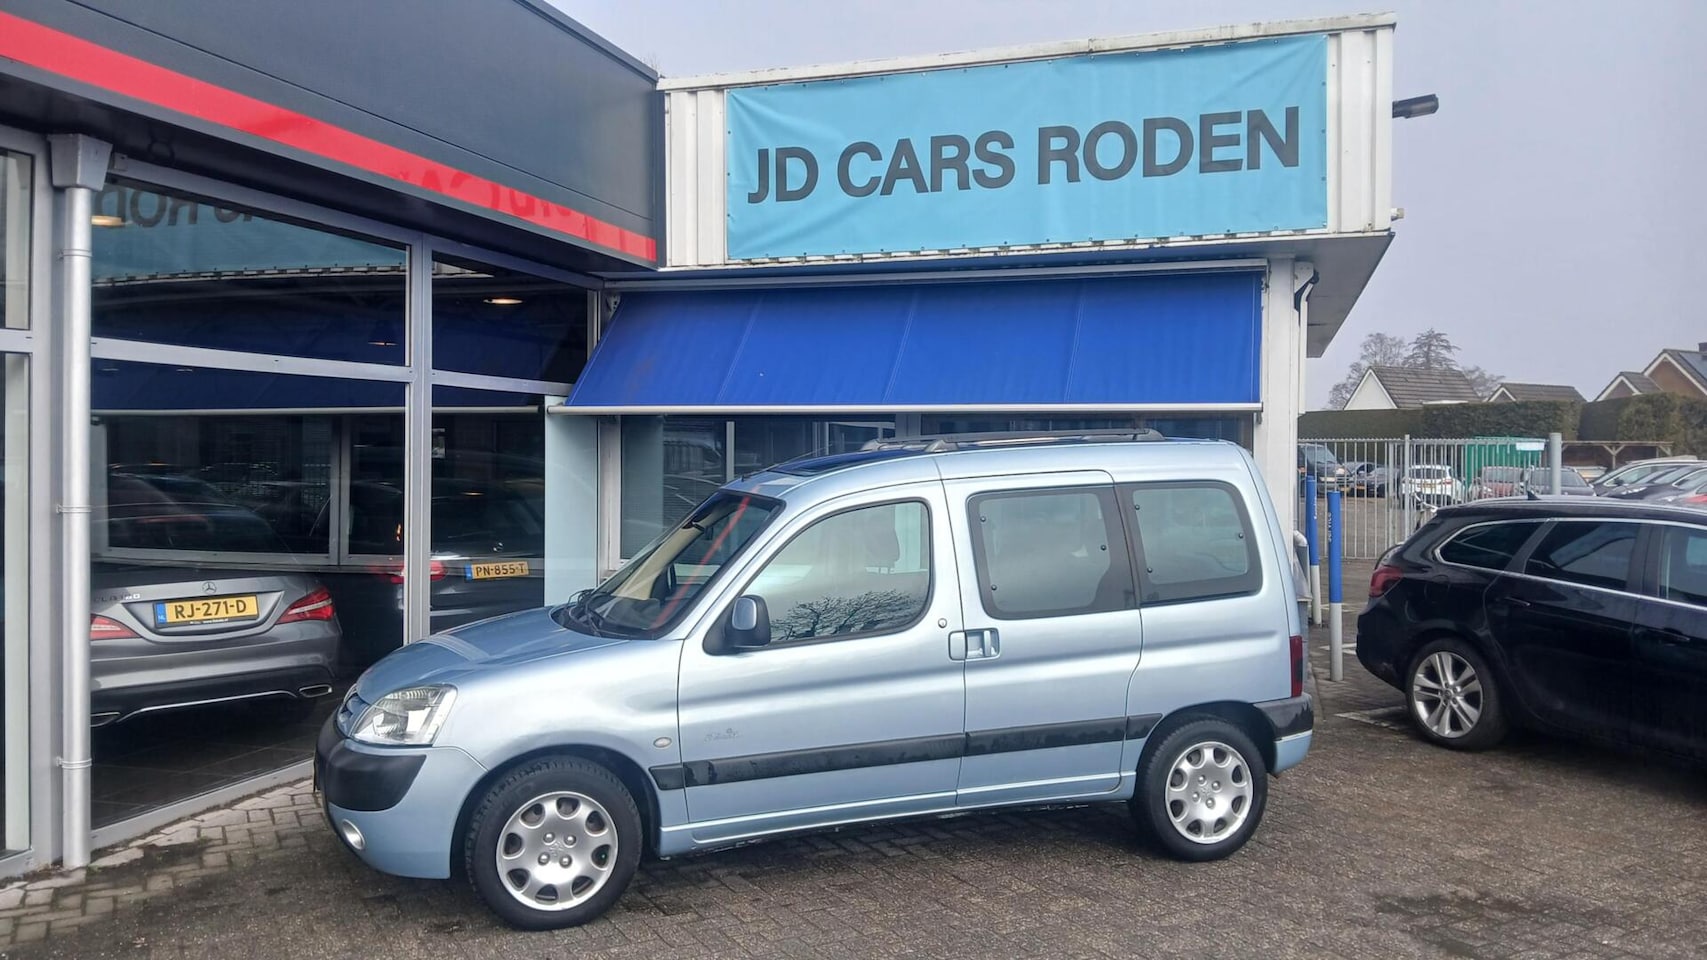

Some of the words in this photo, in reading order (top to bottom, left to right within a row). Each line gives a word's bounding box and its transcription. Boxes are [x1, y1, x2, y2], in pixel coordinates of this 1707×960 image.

[747, 146, 819, 204] JD
[837, 130, 1016, 198] CARS
[1038, 106, 1300, 185] RODEN
[475, 563, 525, 577] PN-855-T
[174, 599, 247, 619] RJ-271-D
